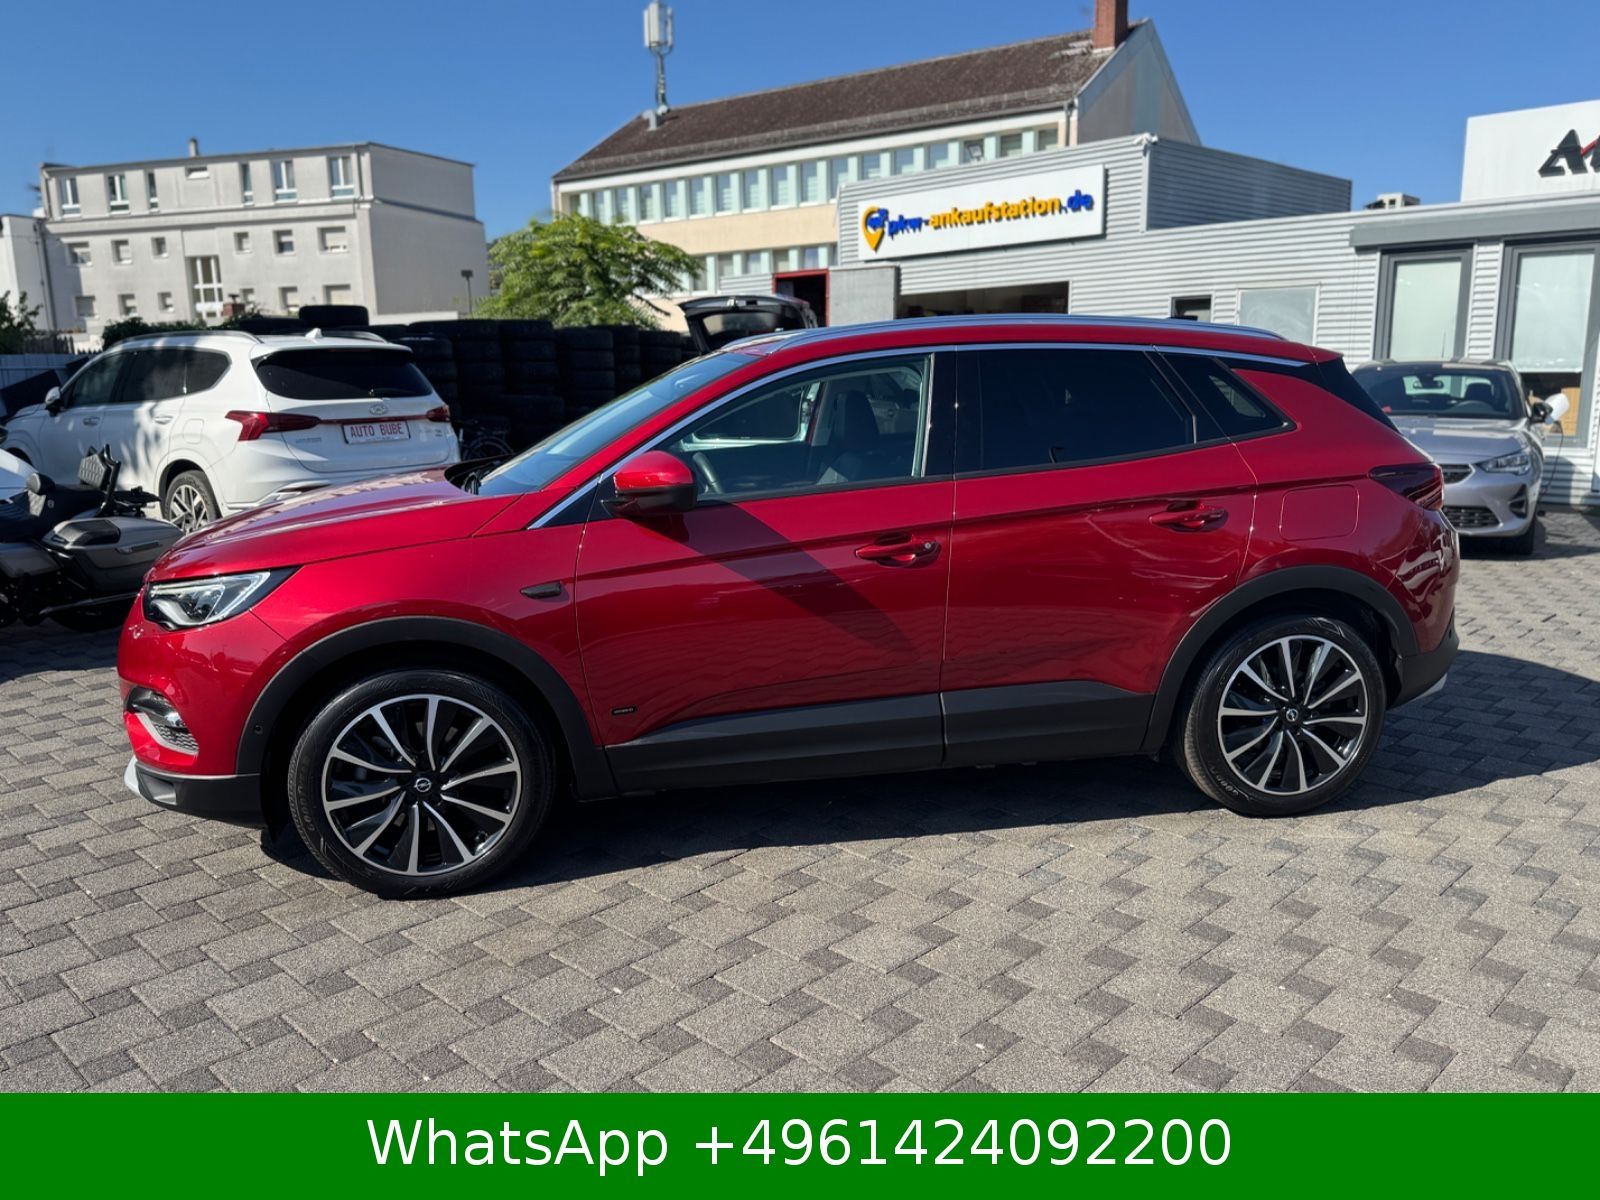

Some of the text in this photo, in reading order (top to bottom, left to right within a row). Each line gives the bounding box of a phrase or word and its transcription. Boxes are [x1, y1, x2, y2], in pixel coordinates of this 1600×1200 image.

[887, 189, 1094, 238] pkw-ankaufstation.de
[350, 423, 404, 438] AUTO BUBE
